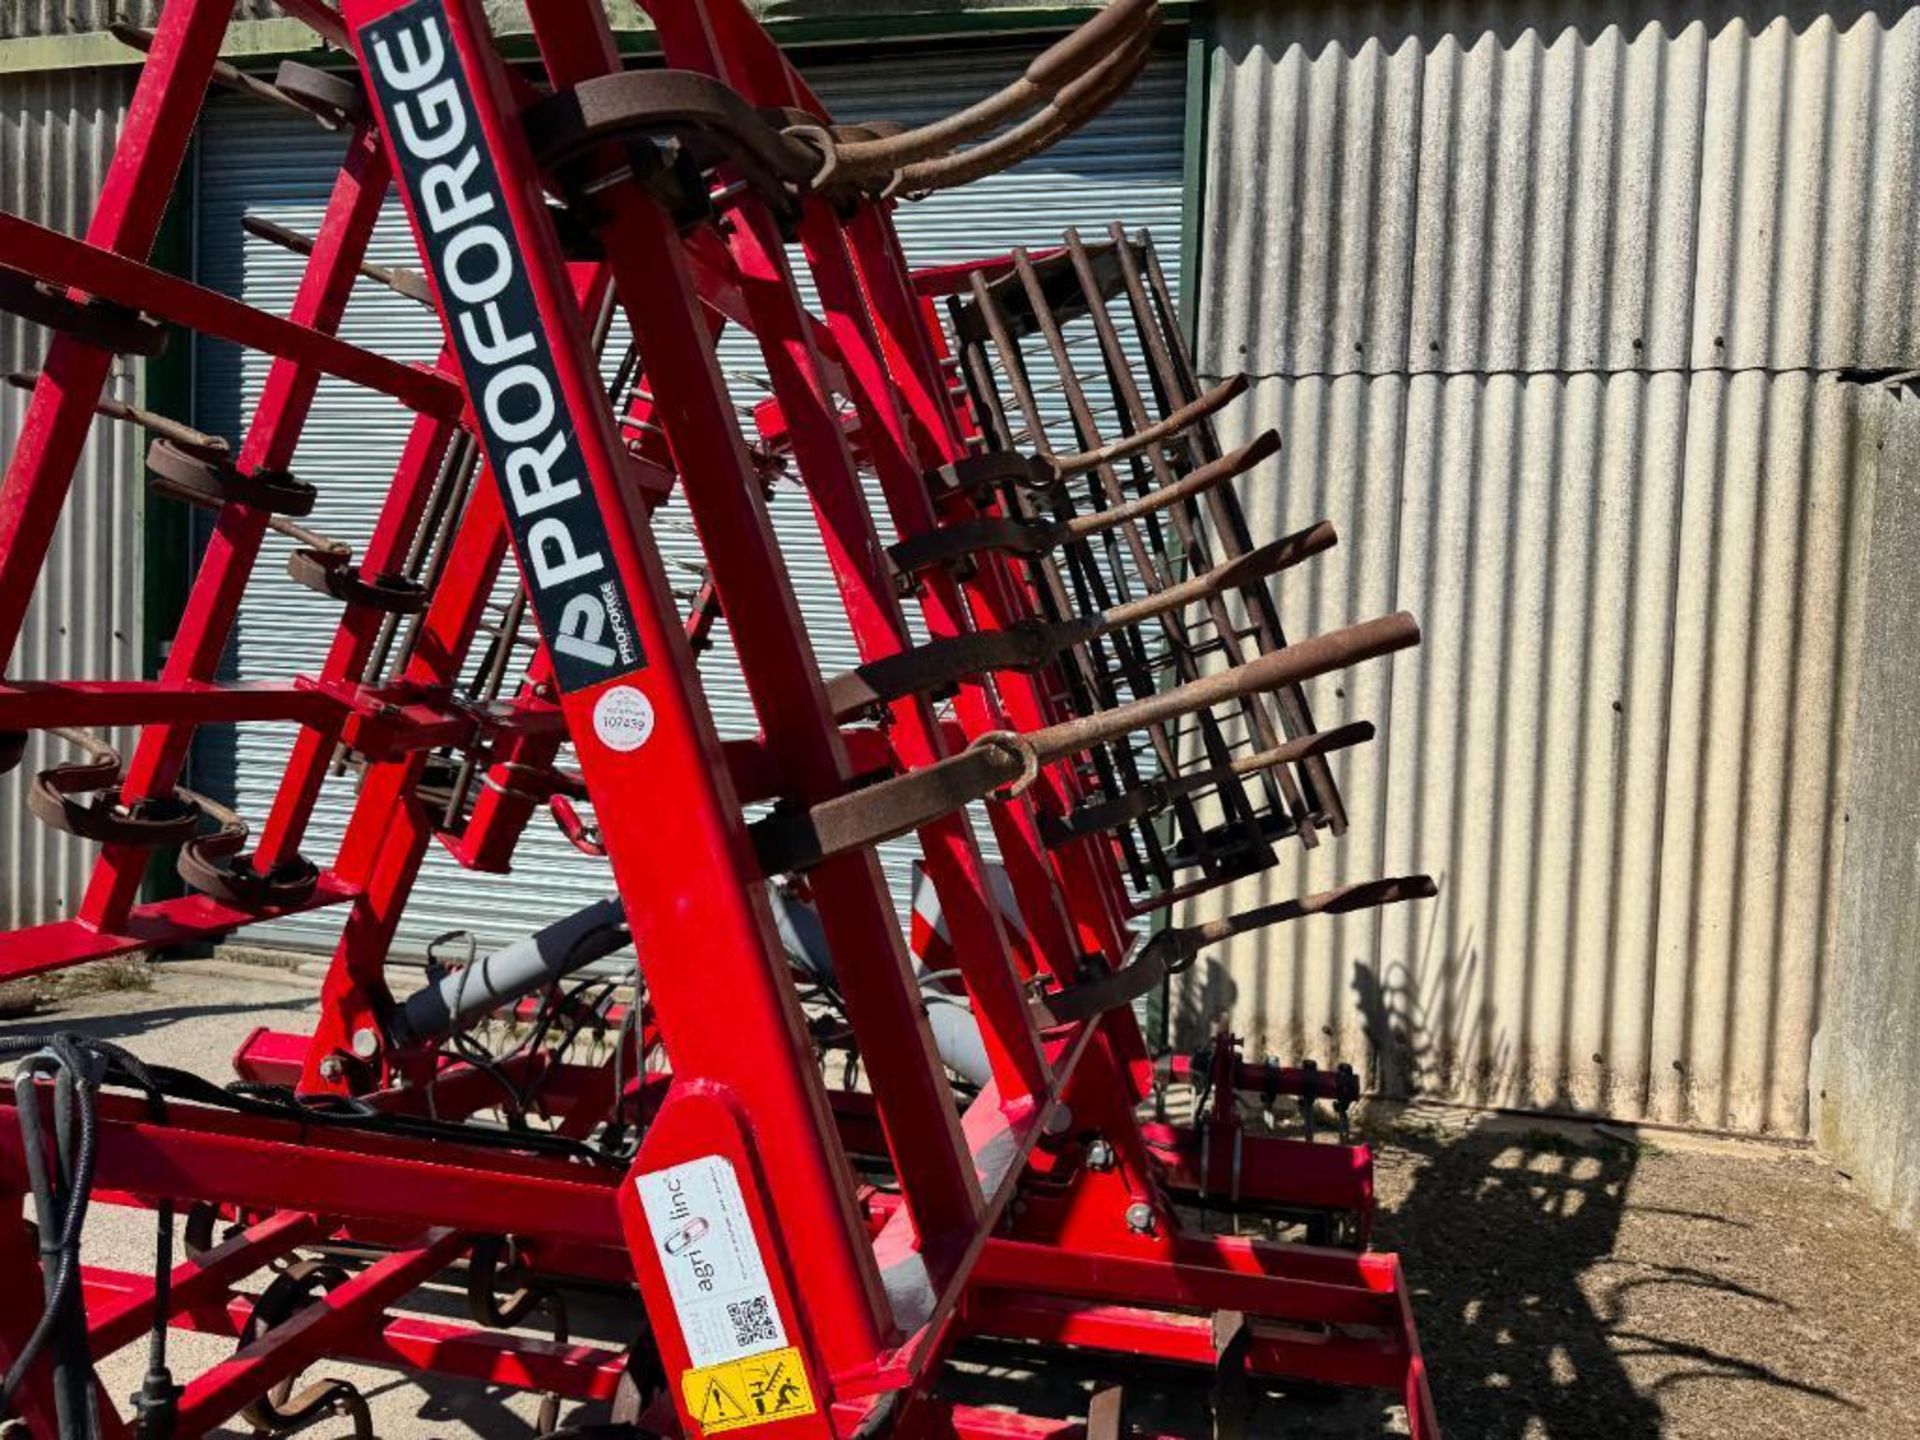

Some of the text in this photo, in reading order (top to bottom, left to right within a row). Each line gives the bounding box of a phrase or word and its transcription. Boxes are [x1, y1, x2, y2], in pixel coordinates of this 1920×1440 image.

[374, 16, 605, 590] PROFORGE
[600, 583, 633, 665] PROFORGE
[668, 1178, 690, 1220] linc
[683, 1250, 715, 1292] agri
